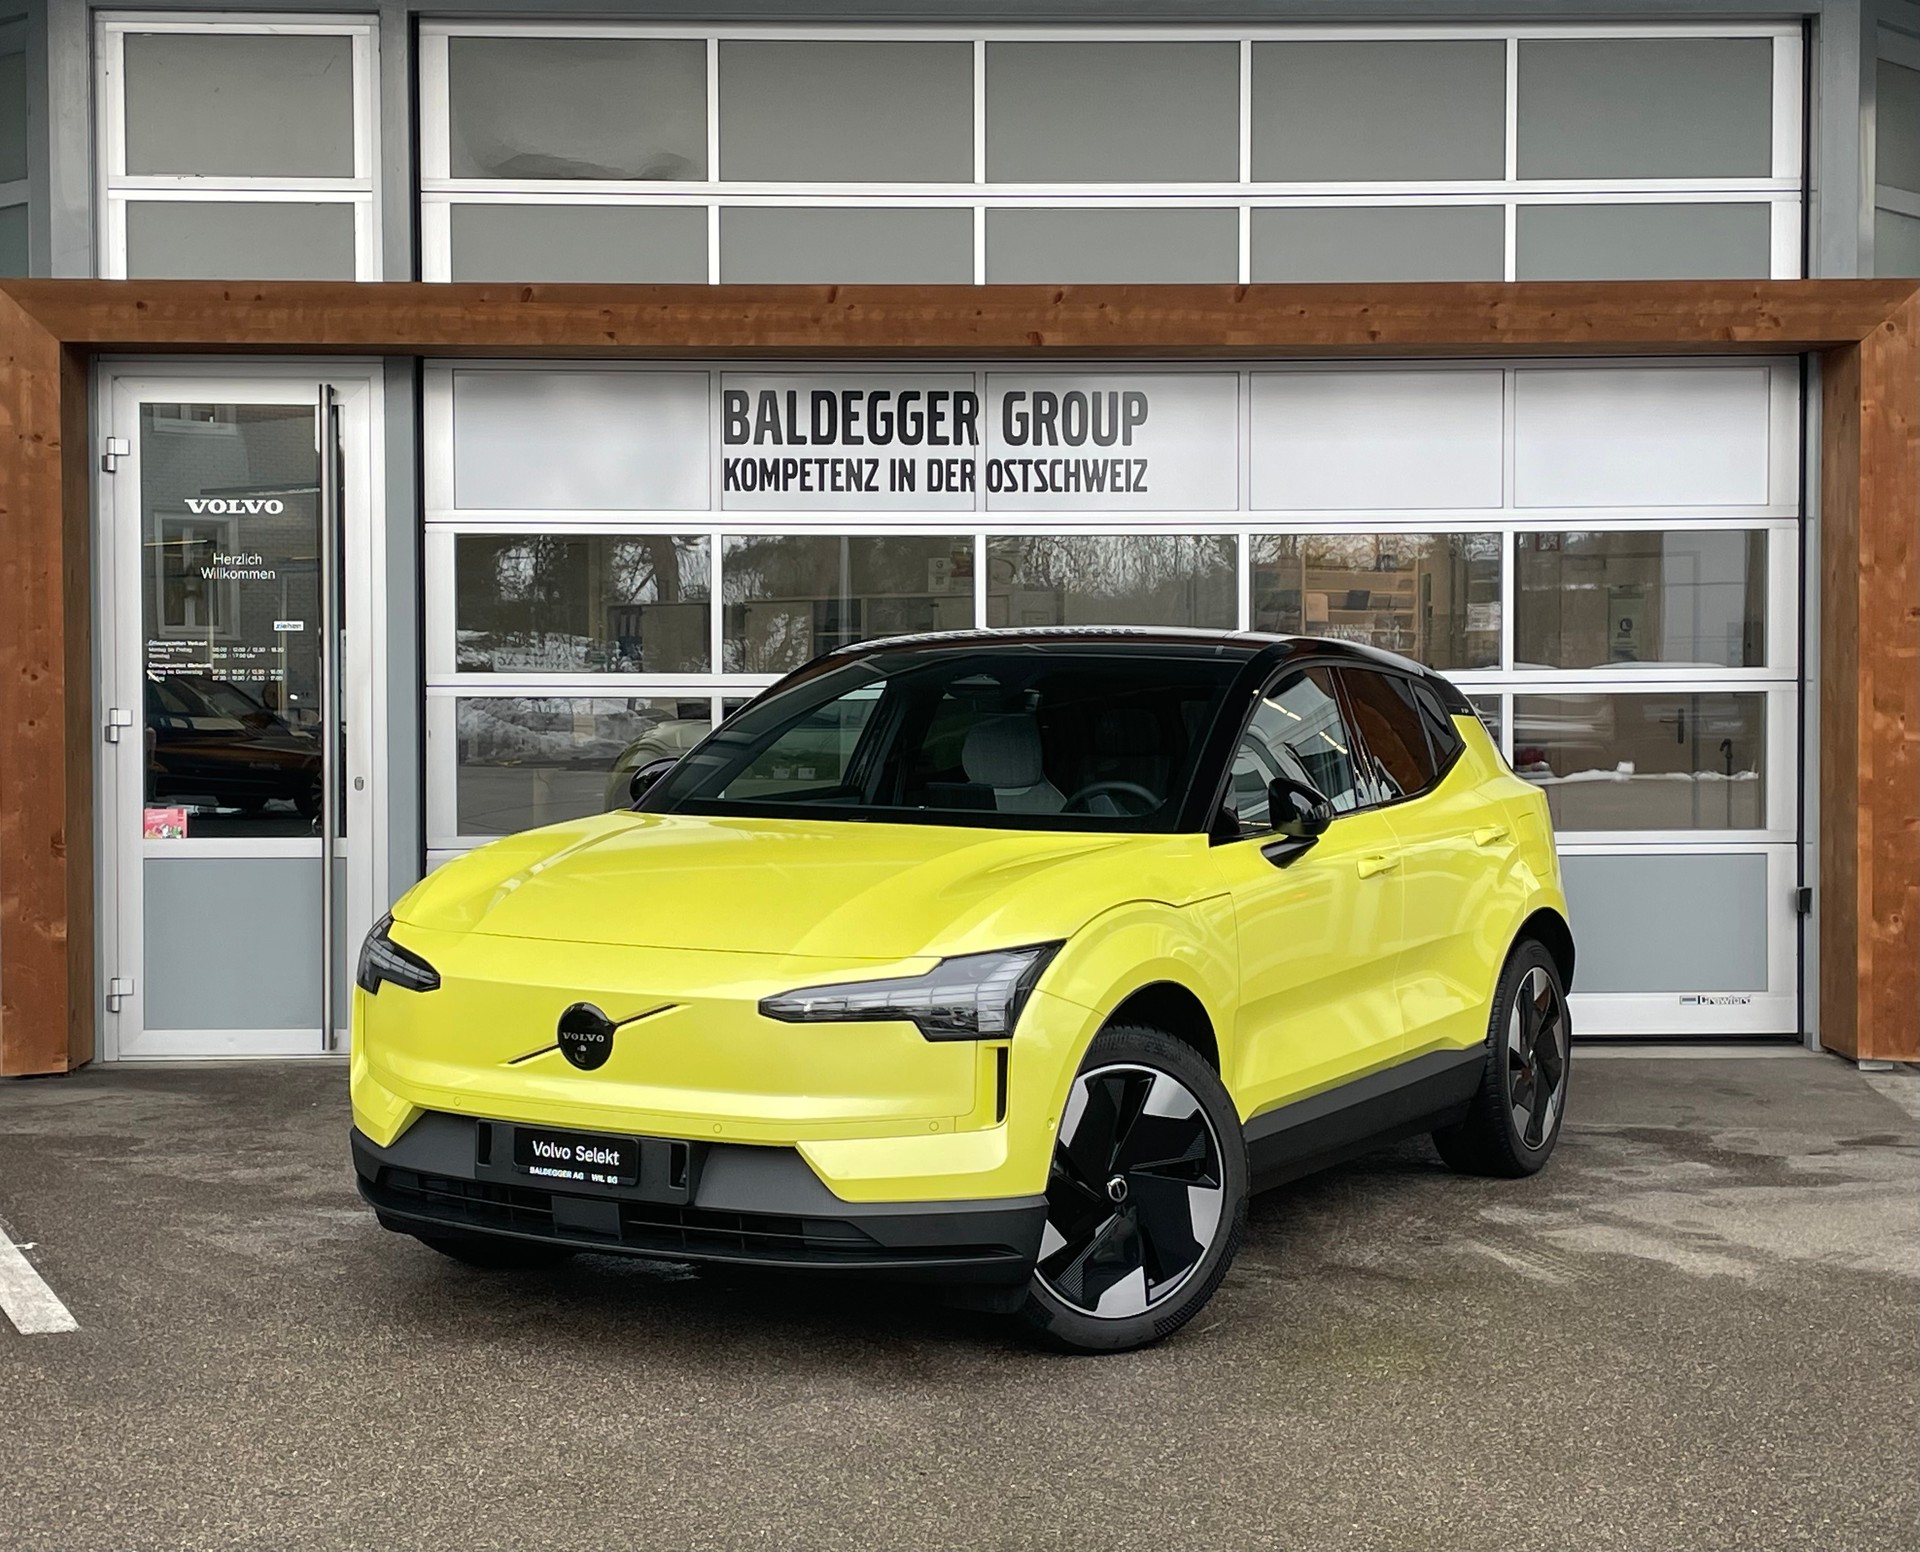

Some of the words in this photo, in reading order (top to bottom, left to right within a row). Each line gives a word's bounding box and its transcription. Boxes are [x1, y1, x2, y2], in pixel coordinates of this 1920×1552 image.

[723, 390, 980, 446] BALDEGGER
[1002, 390, 1149, 447] GROUP
[723, 457, 879, 493] KOMPETENZ
[889, 457, 916, 493] IN
[926, 457, 976, 493] DER
[985, 457, 1149, 493] OSTSCHWEIZ
[184, 498, 284, 515] VOLVO
[213, 552, 263, 565] Herzlich
[200, 566, 276, 580] Willkommen
[562, 1031, 605, 1043] VOLVO
[532, 1139, 571, 1160] Volvo
[575, 1145, 620, 1166] Selekt
[572, 1171, 584, 1180] AG
